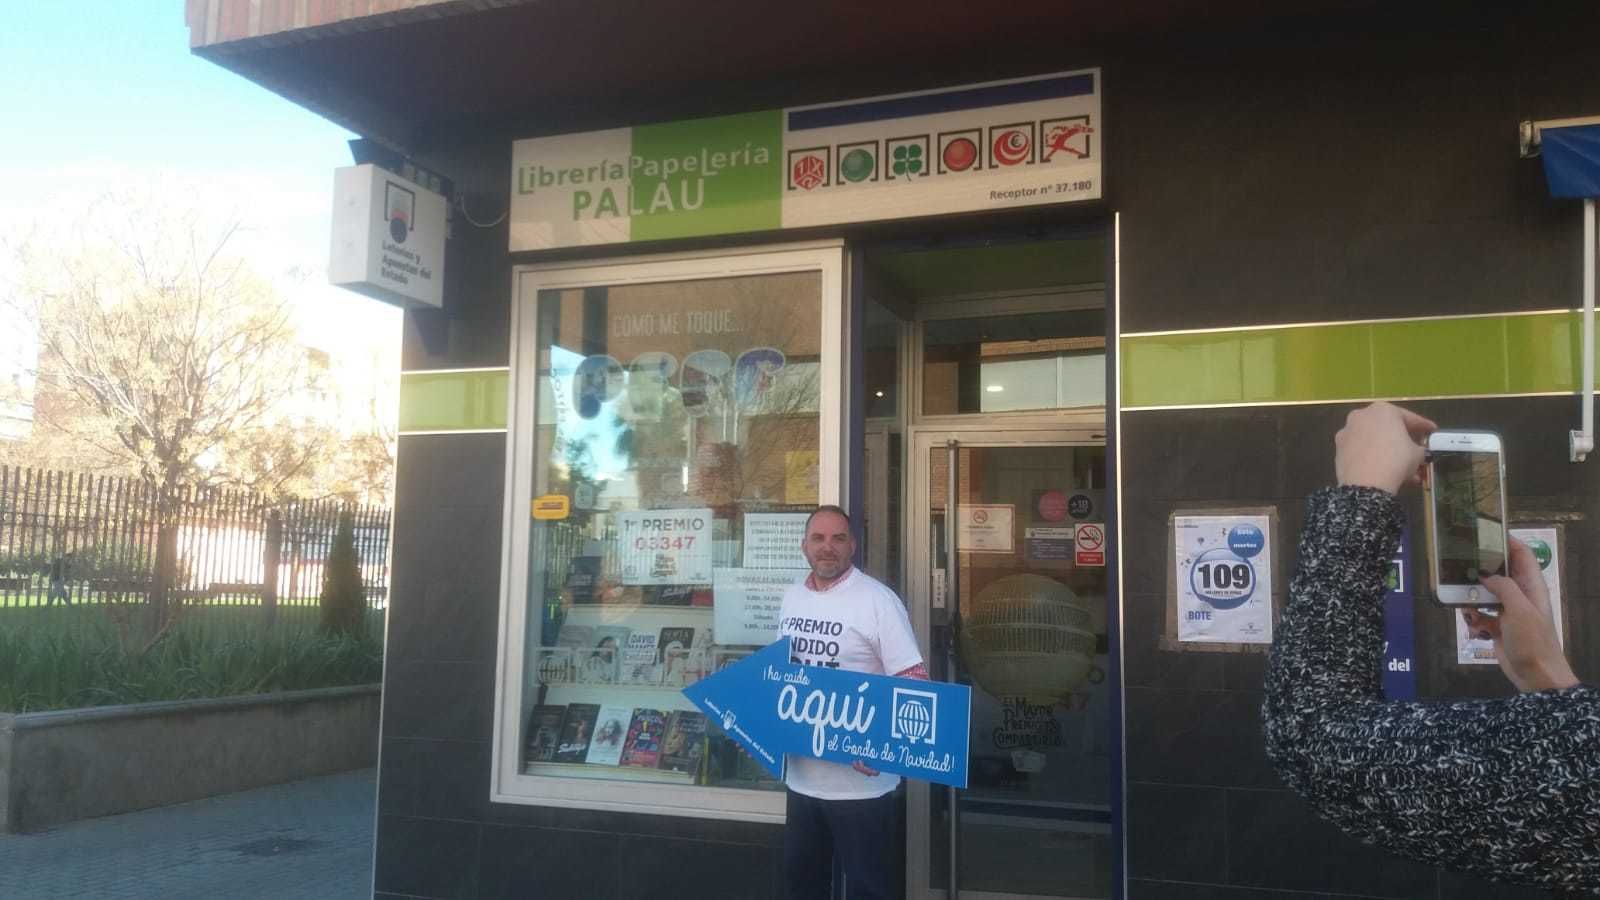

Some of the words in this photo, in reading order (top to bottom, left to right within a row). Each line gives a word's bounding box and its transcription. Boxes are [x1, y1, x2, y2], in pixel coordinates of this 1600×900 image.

[518, 159, 624, 194] Librería
[573, 178, 705, 221] PALAU
[989, 186, 1038, 201] Receptor
[1054, 179, 1092, 195] 37.180
[614, 312, 654, 337] COMO
[659, 311, 680, 336] ME
[641, 517, 705, 532] PREMIO
[634, 535, 696, 551] 03347
[1197, 563, 1251, 589] 109
[788, 617, 843, 637] PREMIO
[1188, 610, 1212, 621] BOTE
[1387, 658, 1411, 672] del
[777, 681, 876, 758] aquí
[827, 733, 839, 752] el
[842, 735, 879, 760] Gordo
[880, 744, 896, 762] de
[898, 745, 956, 773] Navidad!
